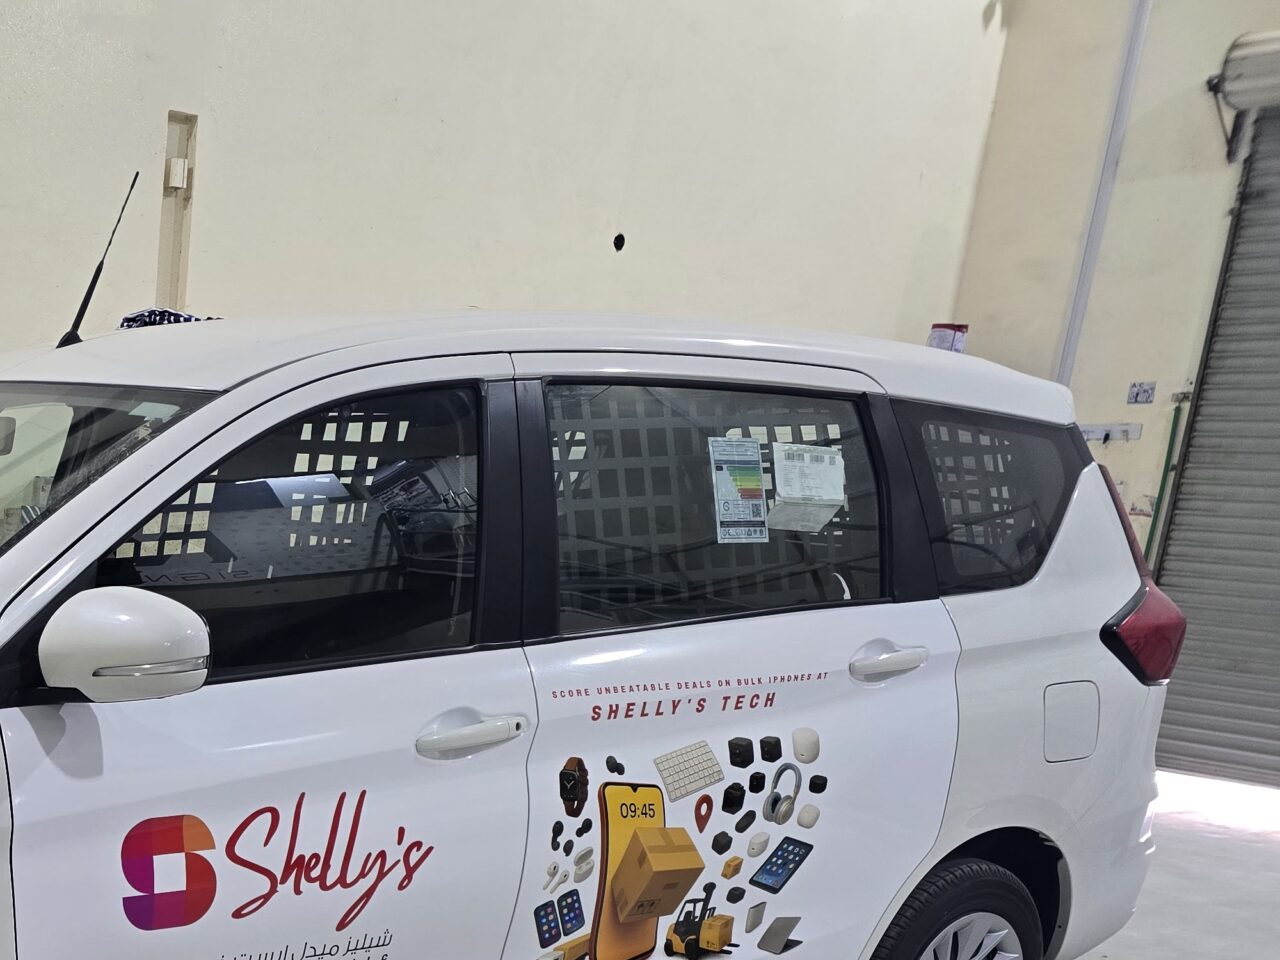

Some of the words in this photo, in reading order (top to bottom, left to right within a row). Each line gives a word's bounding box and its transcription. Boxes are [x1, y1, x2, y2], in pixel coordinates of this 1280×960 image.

[551, 688, 591, 699] SCORE
[596, 682, 671, 695] UNBEATABLE
[677, 679, 713, 690] DEALS
[718, 678, 731, 687] ON
[736, 676, 763, 686] BULK
[768, 673, 813, 684] IPHONES
[816, 671, 829, 680] AT
[591, 697, 707, 721] SHELLY'S
[721, 692, 777, 711] TECH
[620, 802, 656, 819] 09:45
[225, 789, 434, 932] Shelly's
